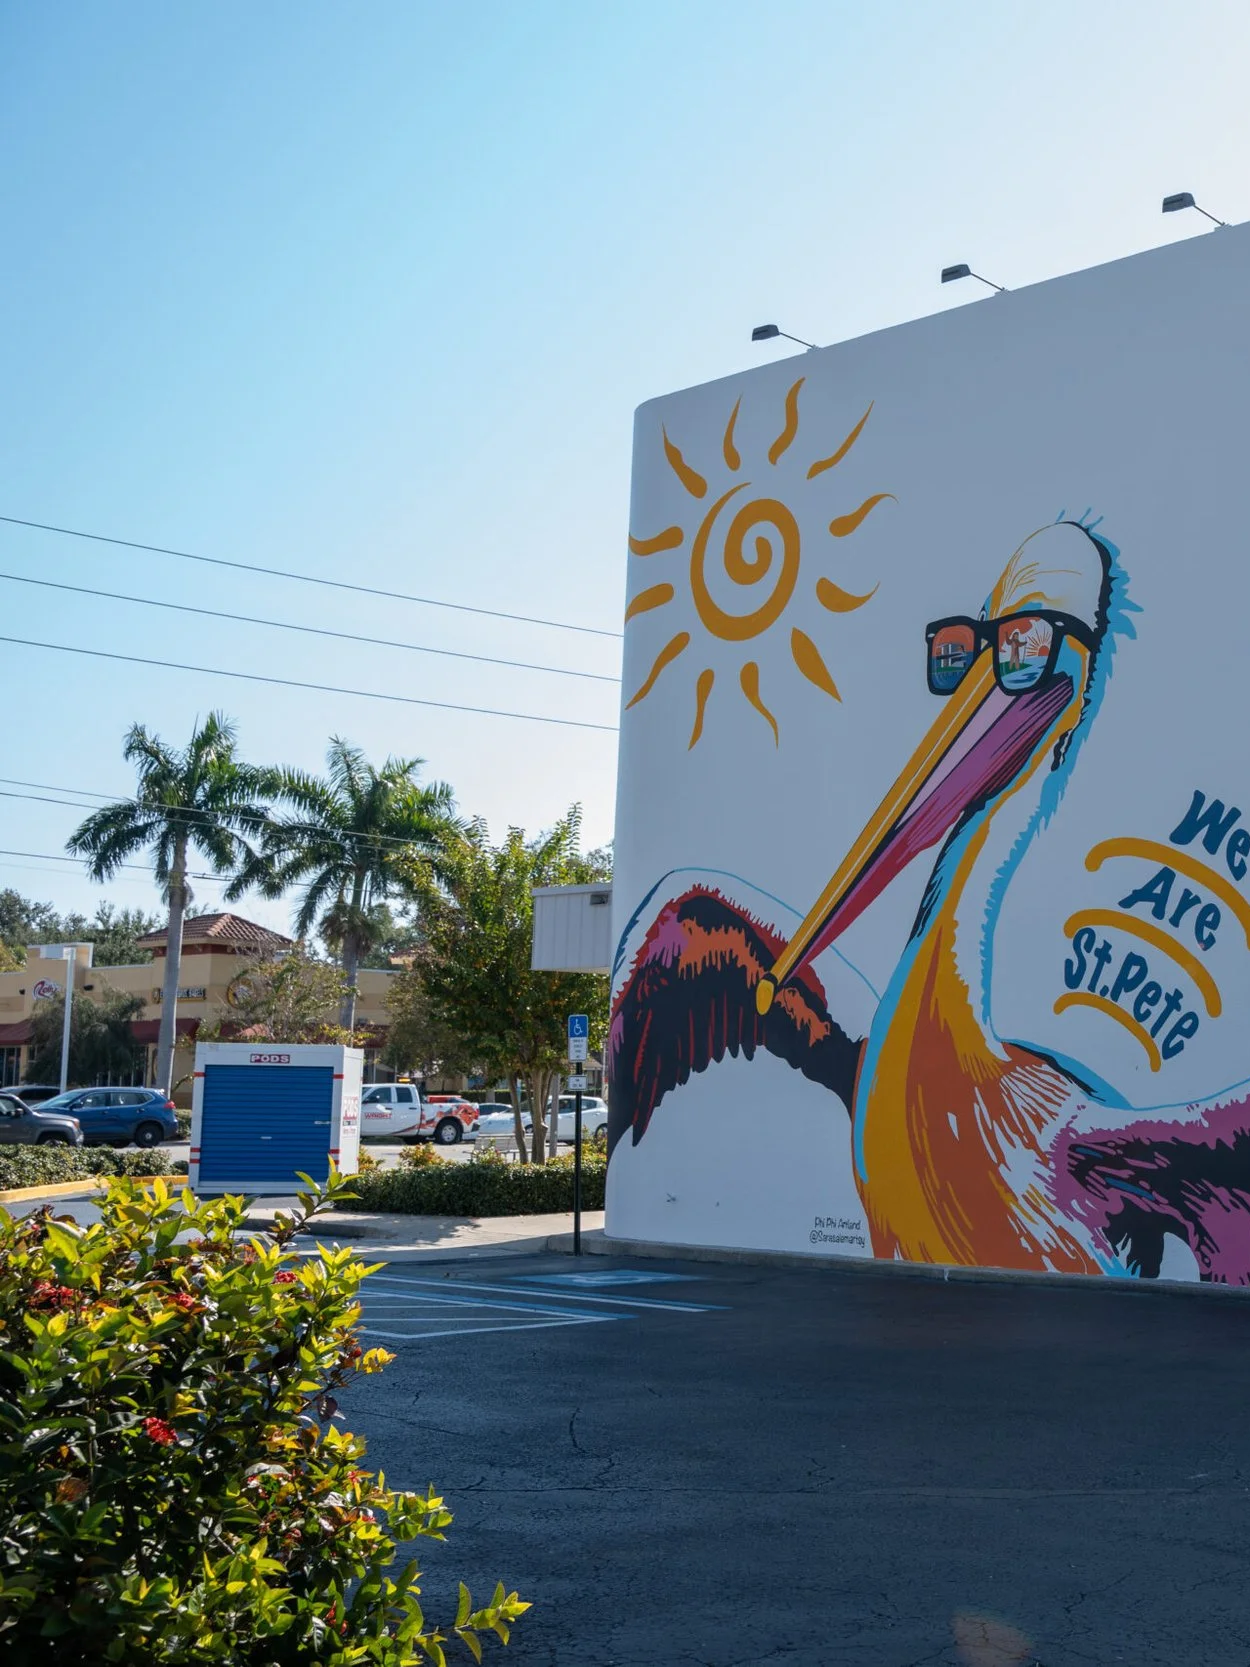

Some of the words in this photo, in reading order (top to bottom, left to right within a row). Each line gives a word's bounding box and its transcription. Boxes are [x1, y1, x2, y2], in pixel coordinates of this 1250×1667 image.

[1169, 790, 1250, 881] We
[1118, 866, 1221, 951] Are
[251, 1055, 289, 1063] PODS
